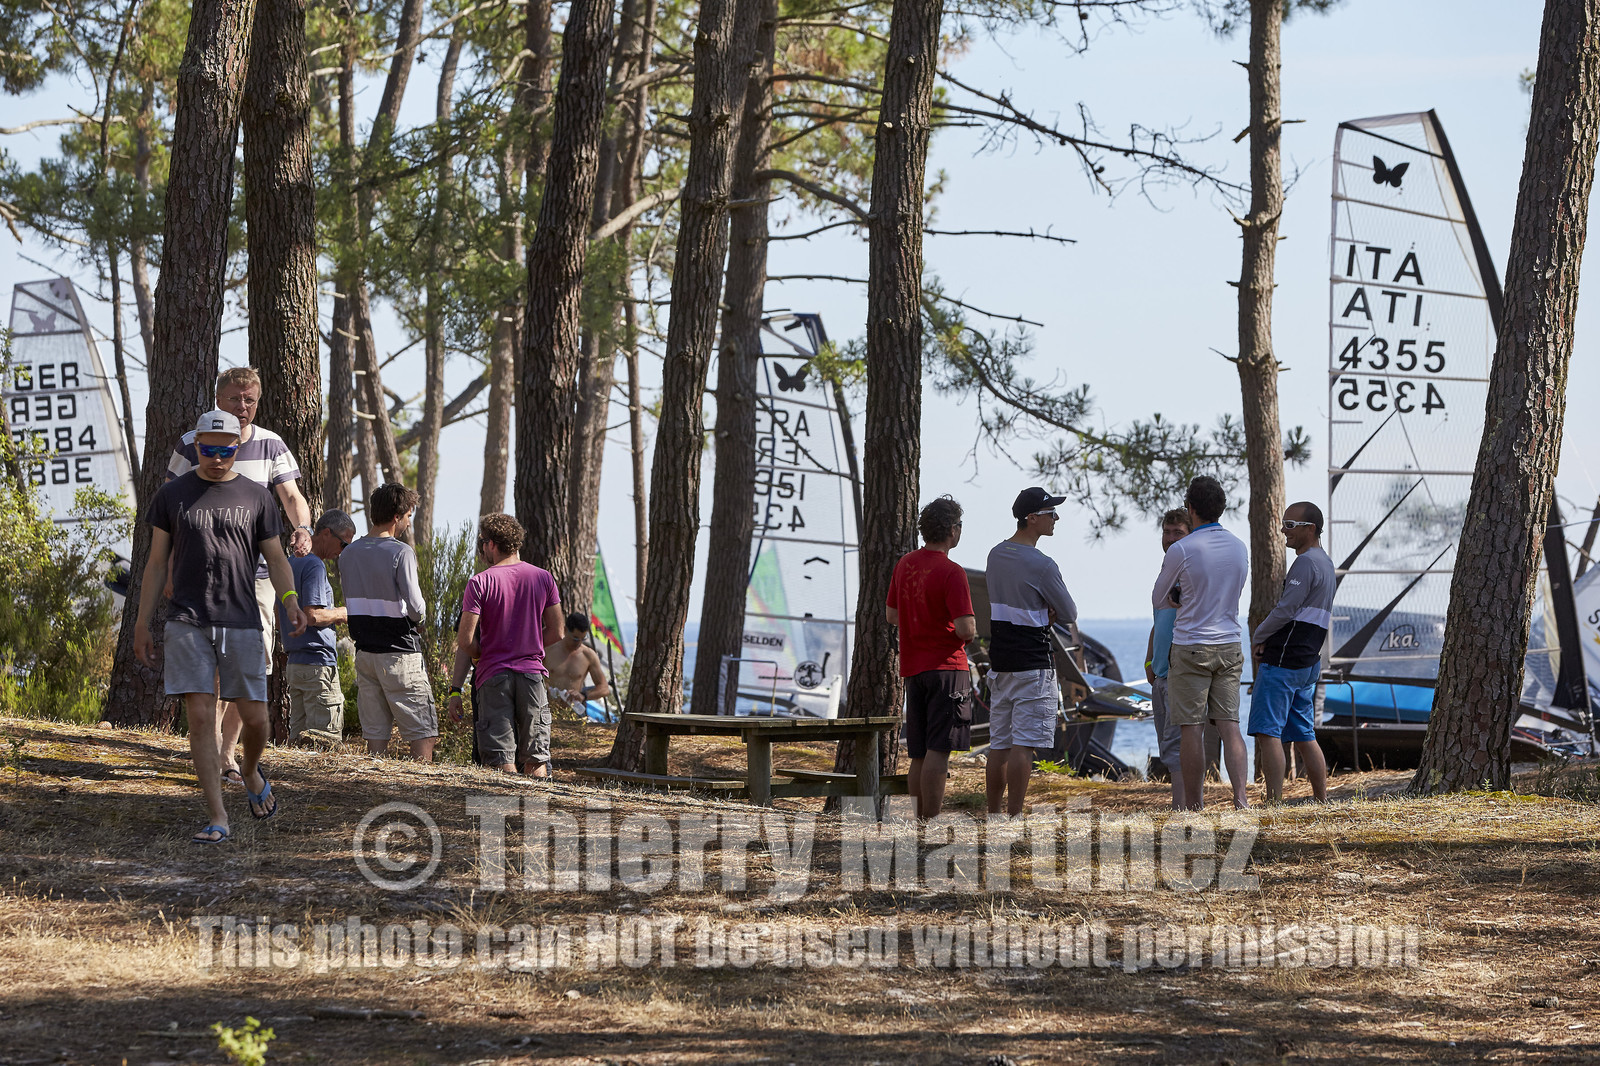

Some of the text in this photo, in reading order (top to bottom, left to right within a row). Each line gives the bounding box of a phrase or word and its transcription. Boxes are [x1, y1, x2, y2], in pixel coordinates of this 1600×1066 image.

[1346, 244, 1424, 286] ITA
[1339, 336, 1446, 373] 4355
[14, 362, 79, 390] GER
[177, 501, 251, 530] MONTAÑA
